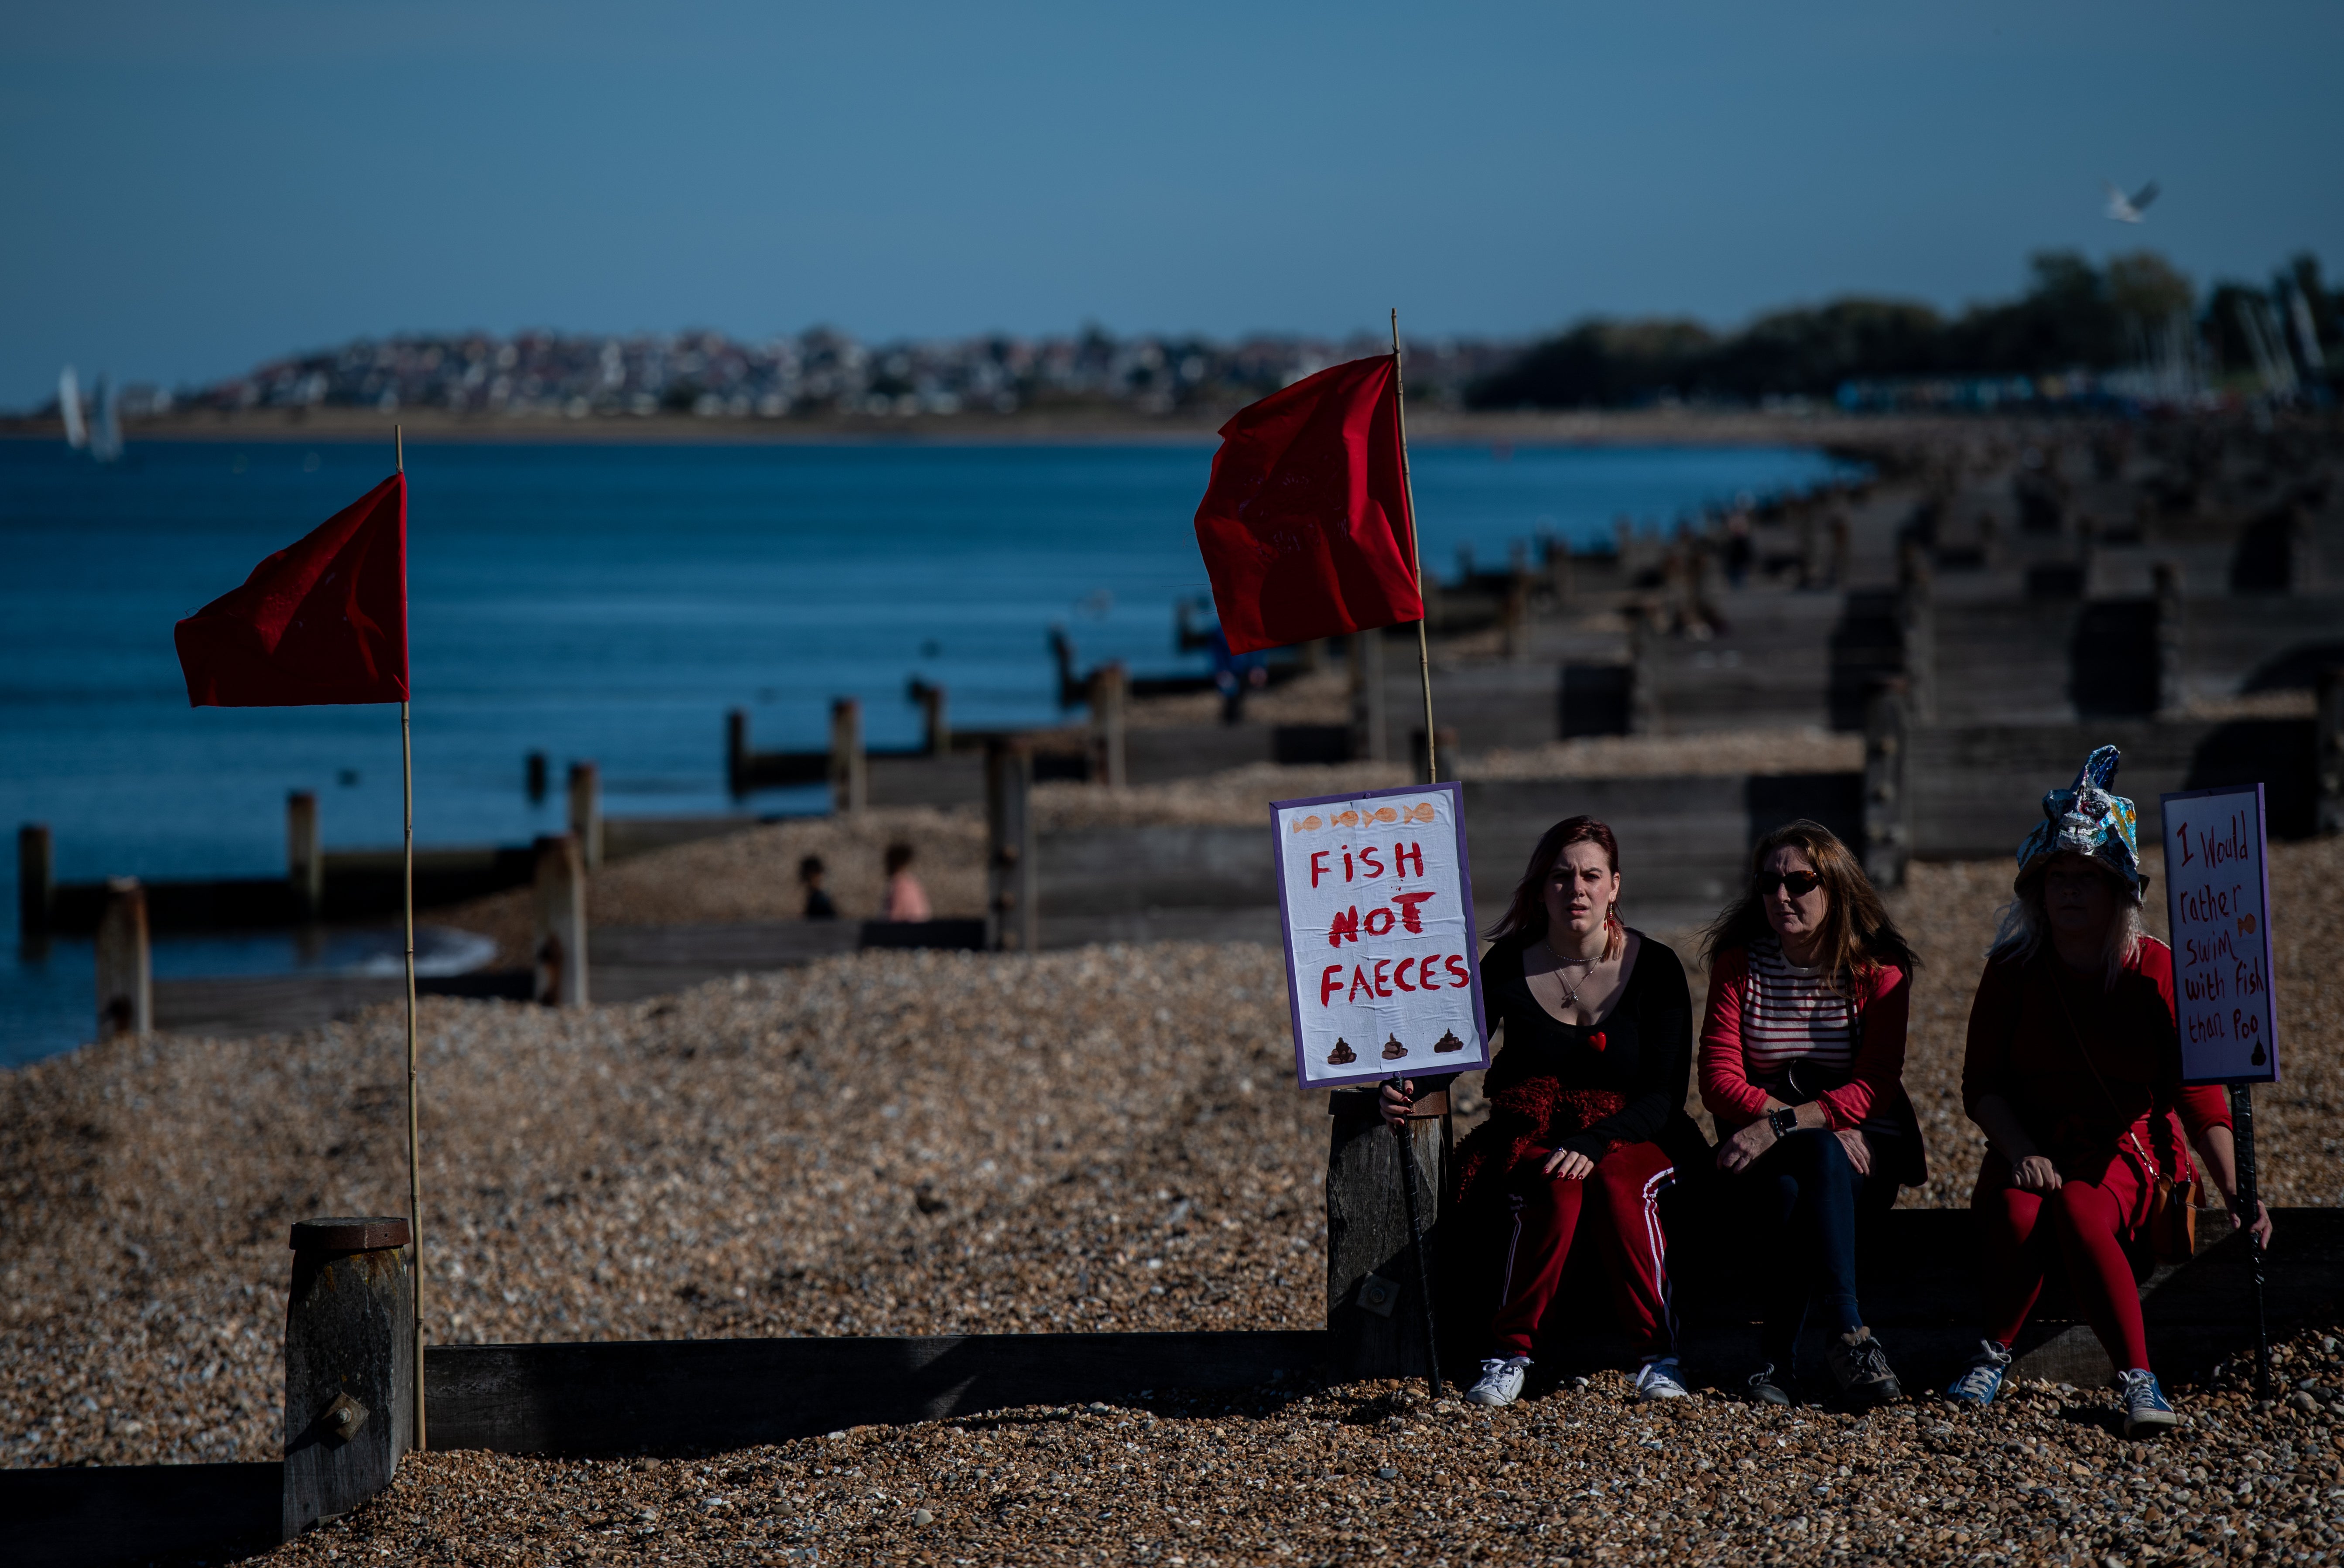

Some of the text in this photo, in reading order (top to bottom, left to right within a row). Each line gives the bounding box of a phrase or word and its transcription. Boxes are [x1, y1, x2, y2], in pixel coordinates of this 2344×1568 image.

[2177, 822, 2194, 867] I
[1329, 892, 1436, 947] NOT
[2180, 885, 2241, 924] rather
[1321, 954, 1470, 1007] FAECES
[2185, 967, 2224, 1001] with
[2189, 1012, 2225, 1043] than
